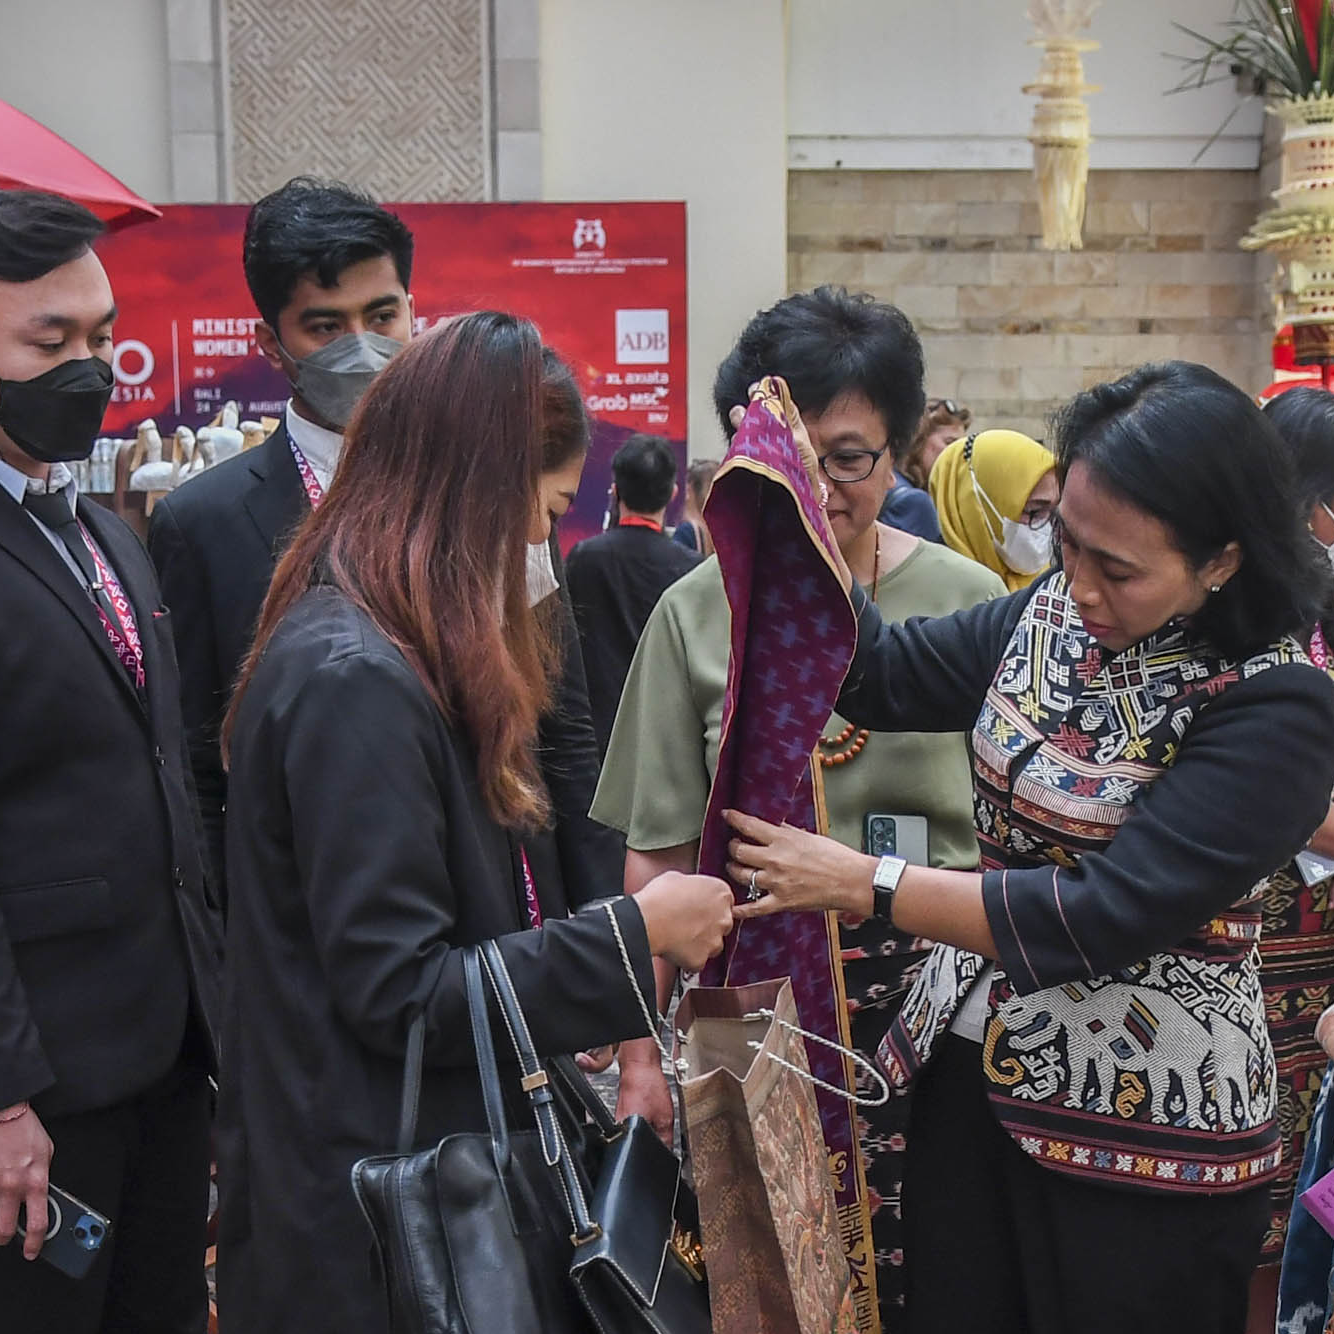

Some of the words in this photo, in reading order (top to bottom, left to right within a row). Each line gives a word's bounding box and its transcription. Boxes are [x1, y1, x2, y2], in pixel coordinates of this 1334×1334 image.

[192, 339, 265, 356] WOMEN'
[619, 331, 667, 351] ADB
[587, 393, 629, 411] Grab
